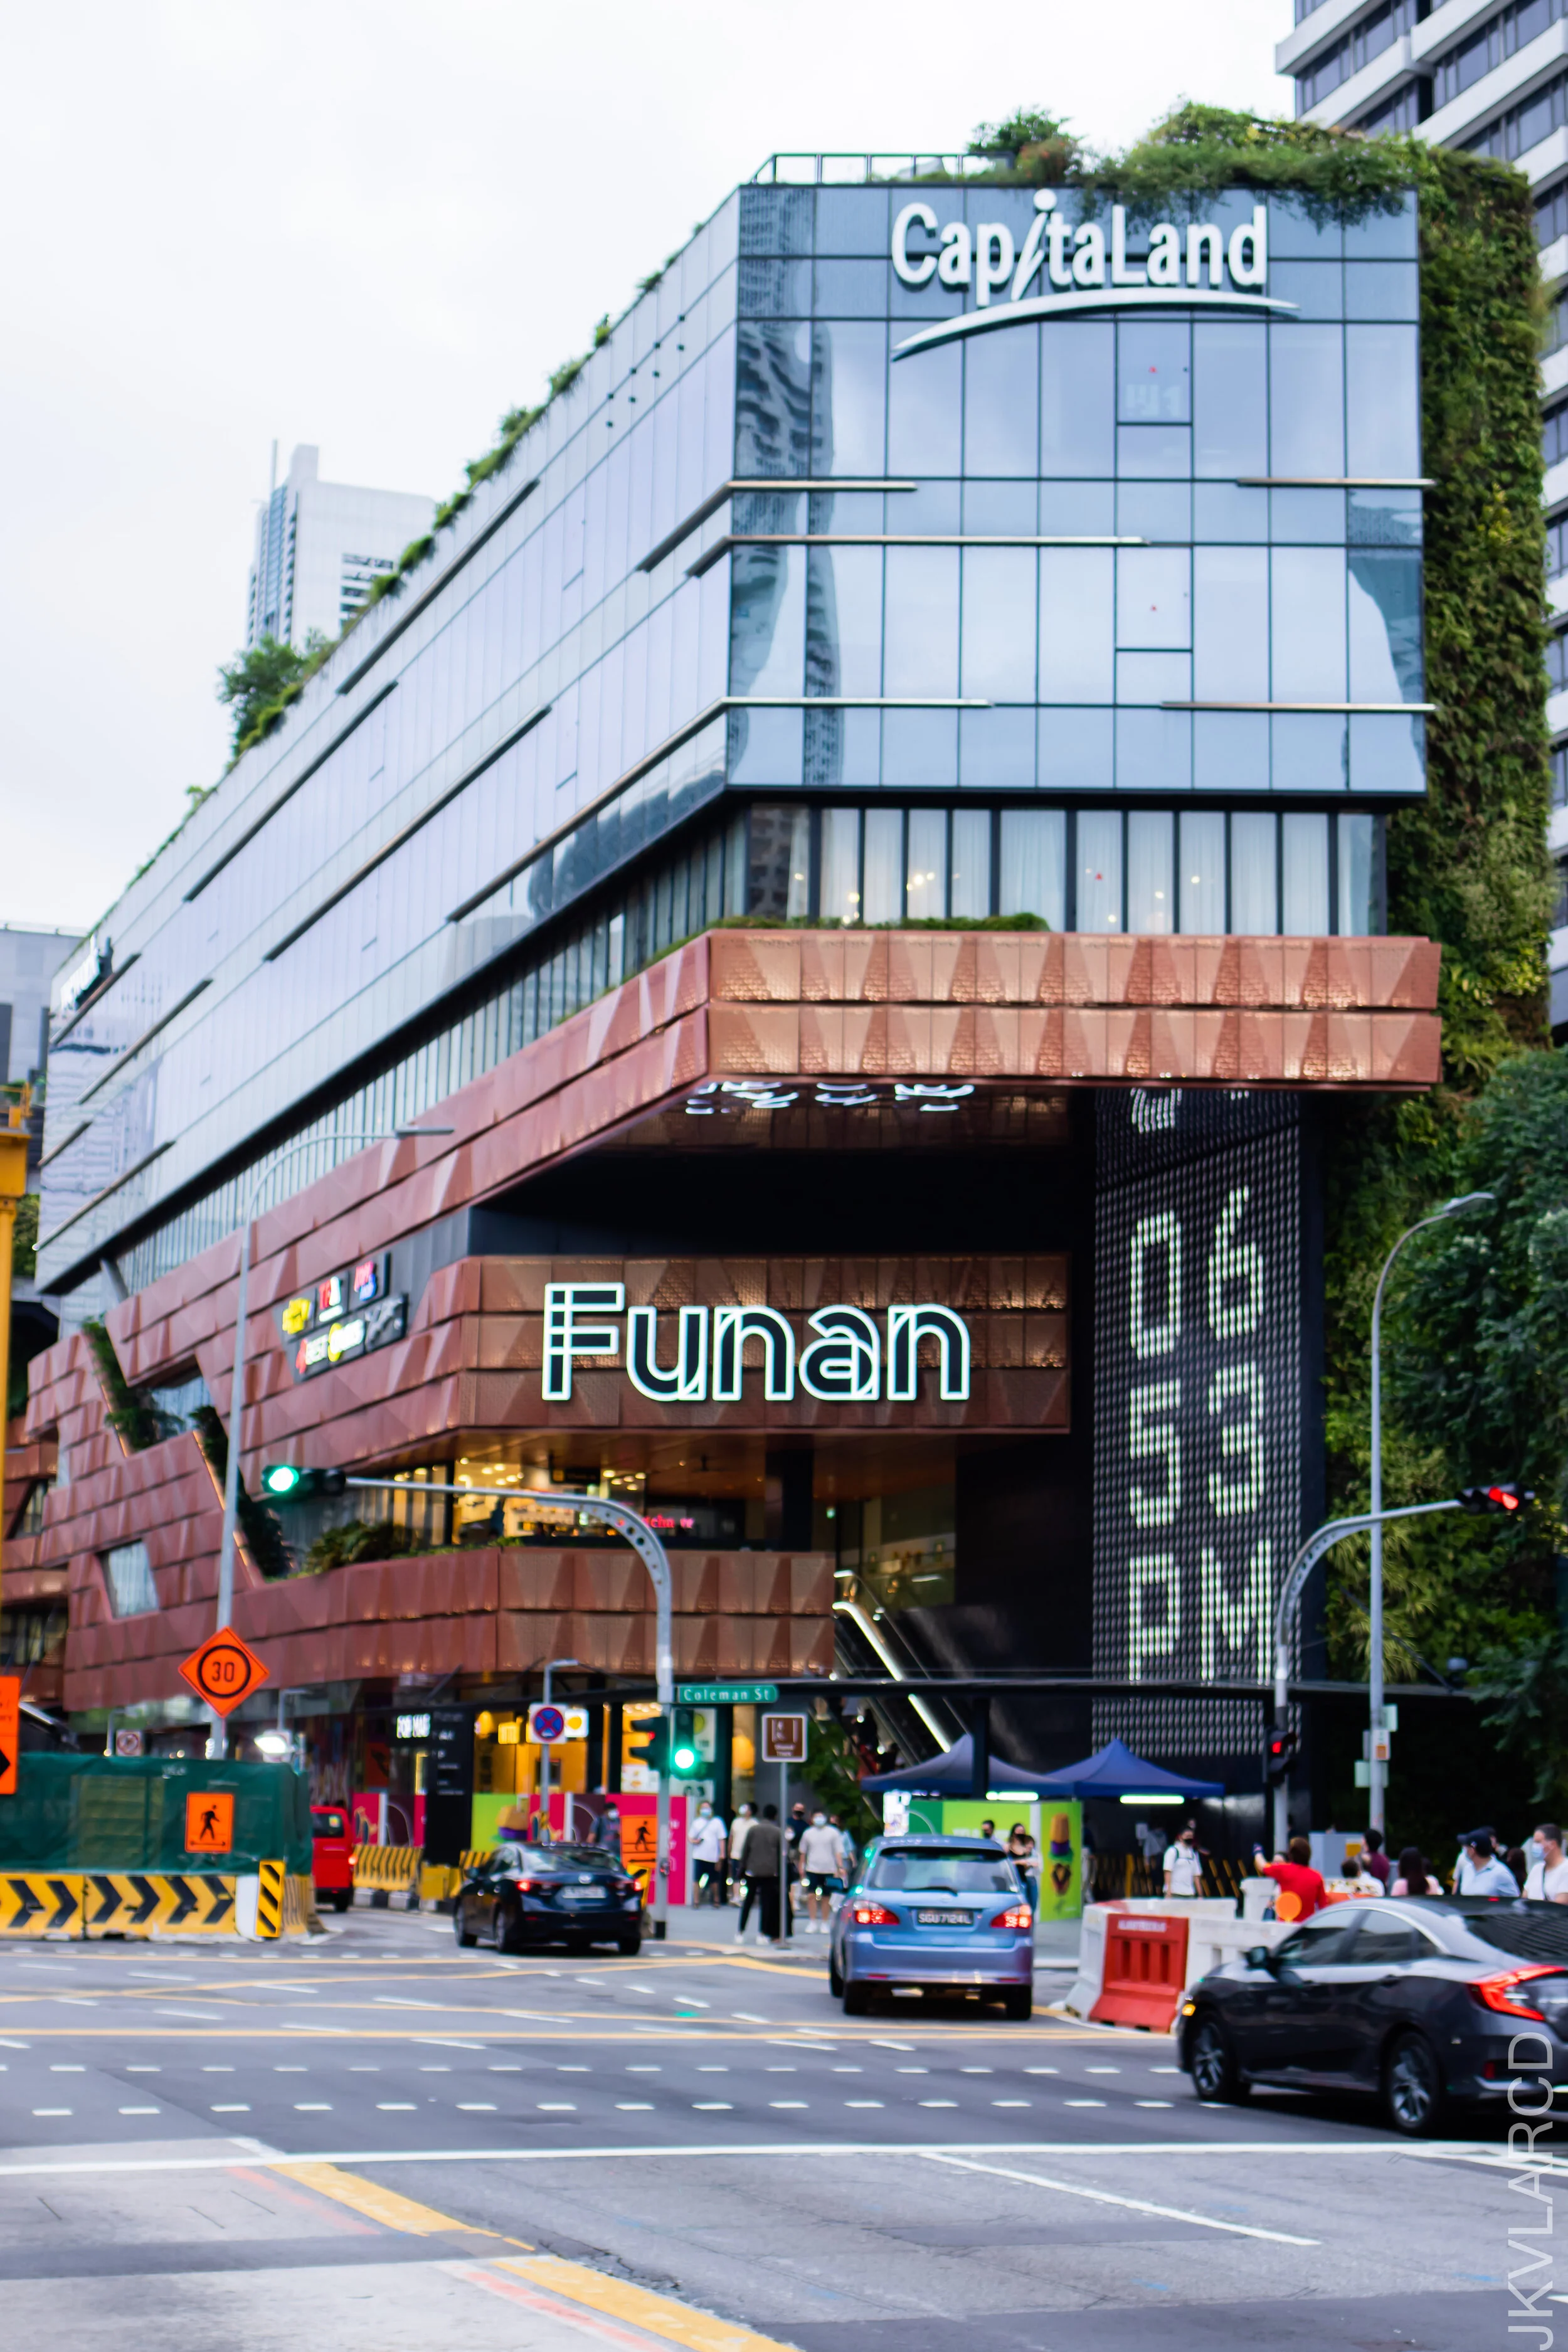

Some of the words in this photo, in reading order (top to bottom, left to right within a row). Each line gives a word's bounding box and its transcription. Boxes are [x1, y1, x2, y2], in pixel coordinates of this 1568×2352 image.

[891, 188, 1267, 307] CapitaLand
[1130, 1185, 1263, 1361] 06
[542, 1282, 970, 1402] Funan
[1130, 1360, 1264, 1529] 53
[211, 1661, 235, 1682] 30
[1129, 1539, 1271, 1686] PM
[684, 1688, 748, 1702] Coleman
[755, 1687, 769, 1700] St
